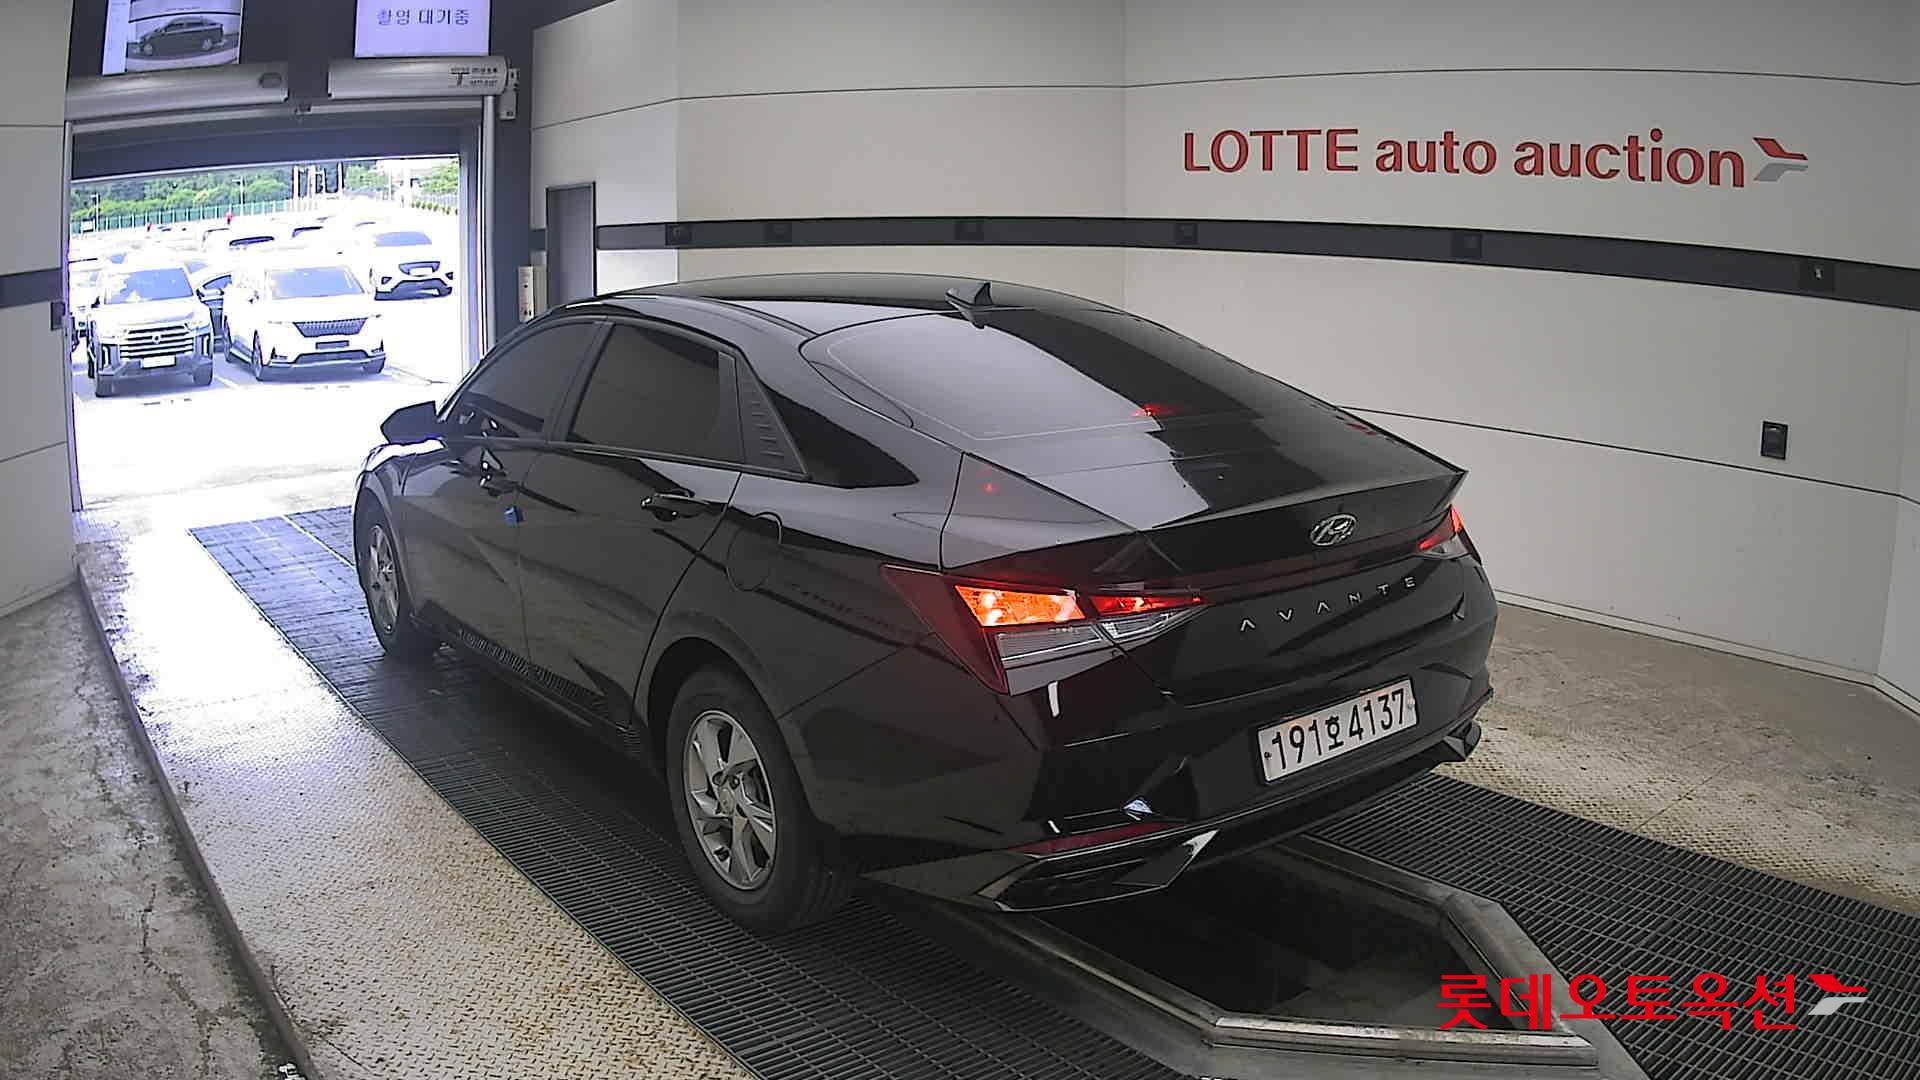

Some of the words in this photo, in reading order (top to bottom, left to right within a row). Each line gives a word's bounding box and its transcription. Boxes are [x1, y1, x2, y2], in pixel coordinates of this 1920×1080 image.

[418, 8, 470, 26] 대기중
[1184, 128, 1359, 173] LOTTE
[1375, 130, 1498, 175] auto
[1513, 127, 1746, 189] auction
[1239, 576, 1418, 632] AVANTE
[1271, 687, 1406, 771] 191호4137
